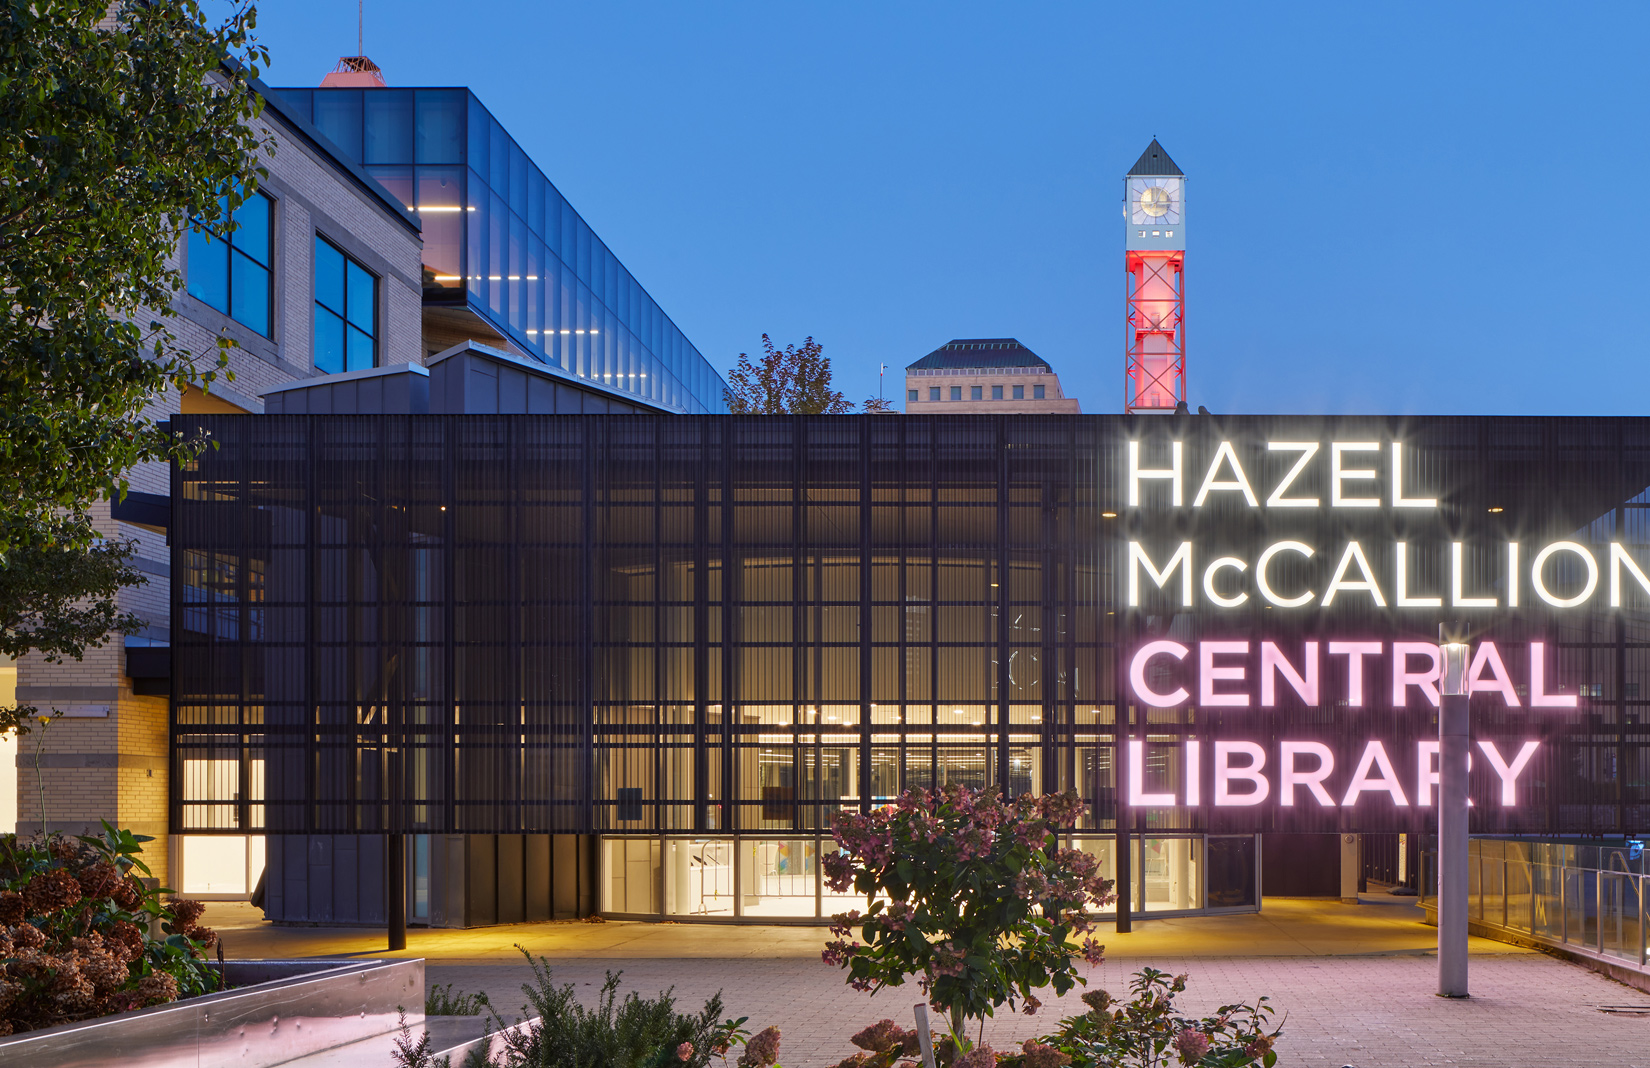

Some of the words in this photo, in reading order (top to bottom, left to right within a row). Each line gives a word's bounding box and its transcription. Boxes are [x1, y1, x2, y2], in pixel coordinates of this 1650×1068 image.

[1128, 440, 1438, 508] HAZEL
[1128, 540, 1650, 608] McCALLION
[1129, 639, 1578, 708] CENTRAL
